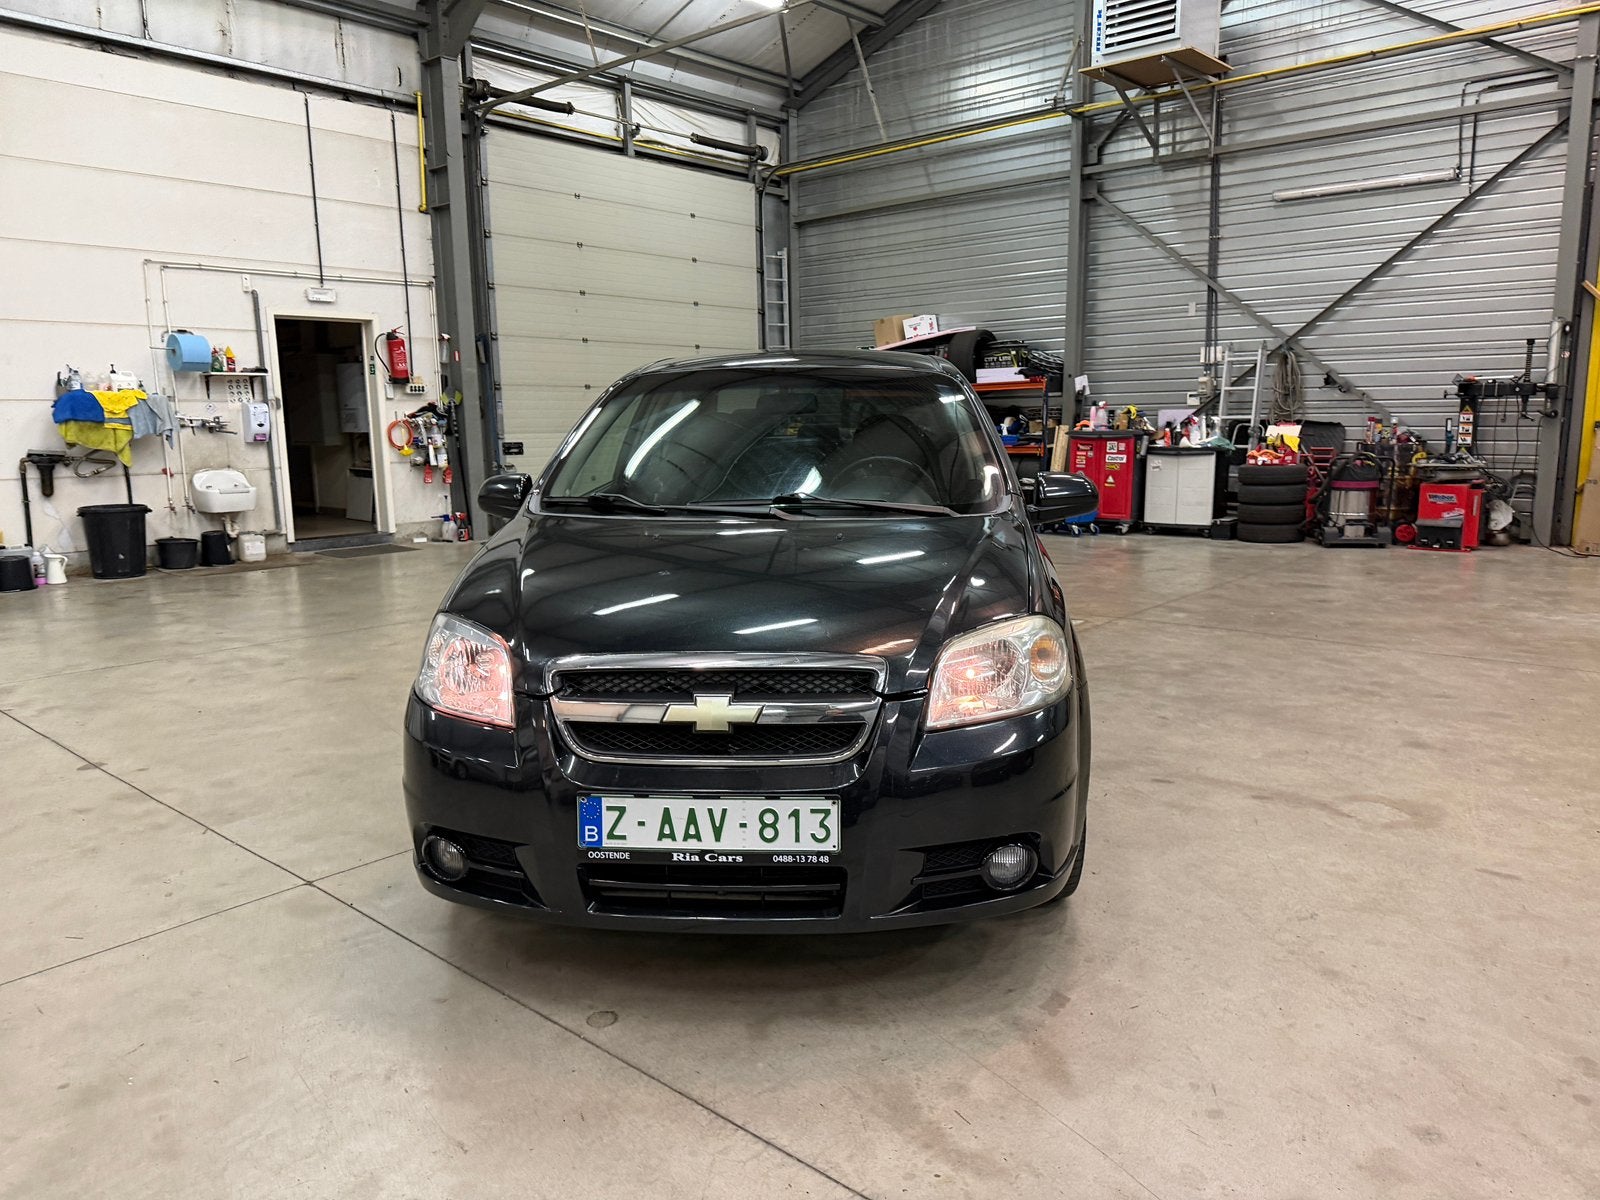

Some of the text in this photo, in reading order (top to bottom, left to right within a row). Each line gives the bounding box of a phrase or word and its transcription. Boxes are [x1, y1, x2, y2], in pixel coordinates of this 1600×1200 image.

[1107, 454, 1126, 462] Castrol
[605, 805, 832, 844] Z-AAV-813
[584, 825, 599, 842] B
[587, 851, 631, 860] OOSTENDE
[671, 852, 744, 863] Ria Cars
[772, 855, 830, 864] 0488-13 78 48
